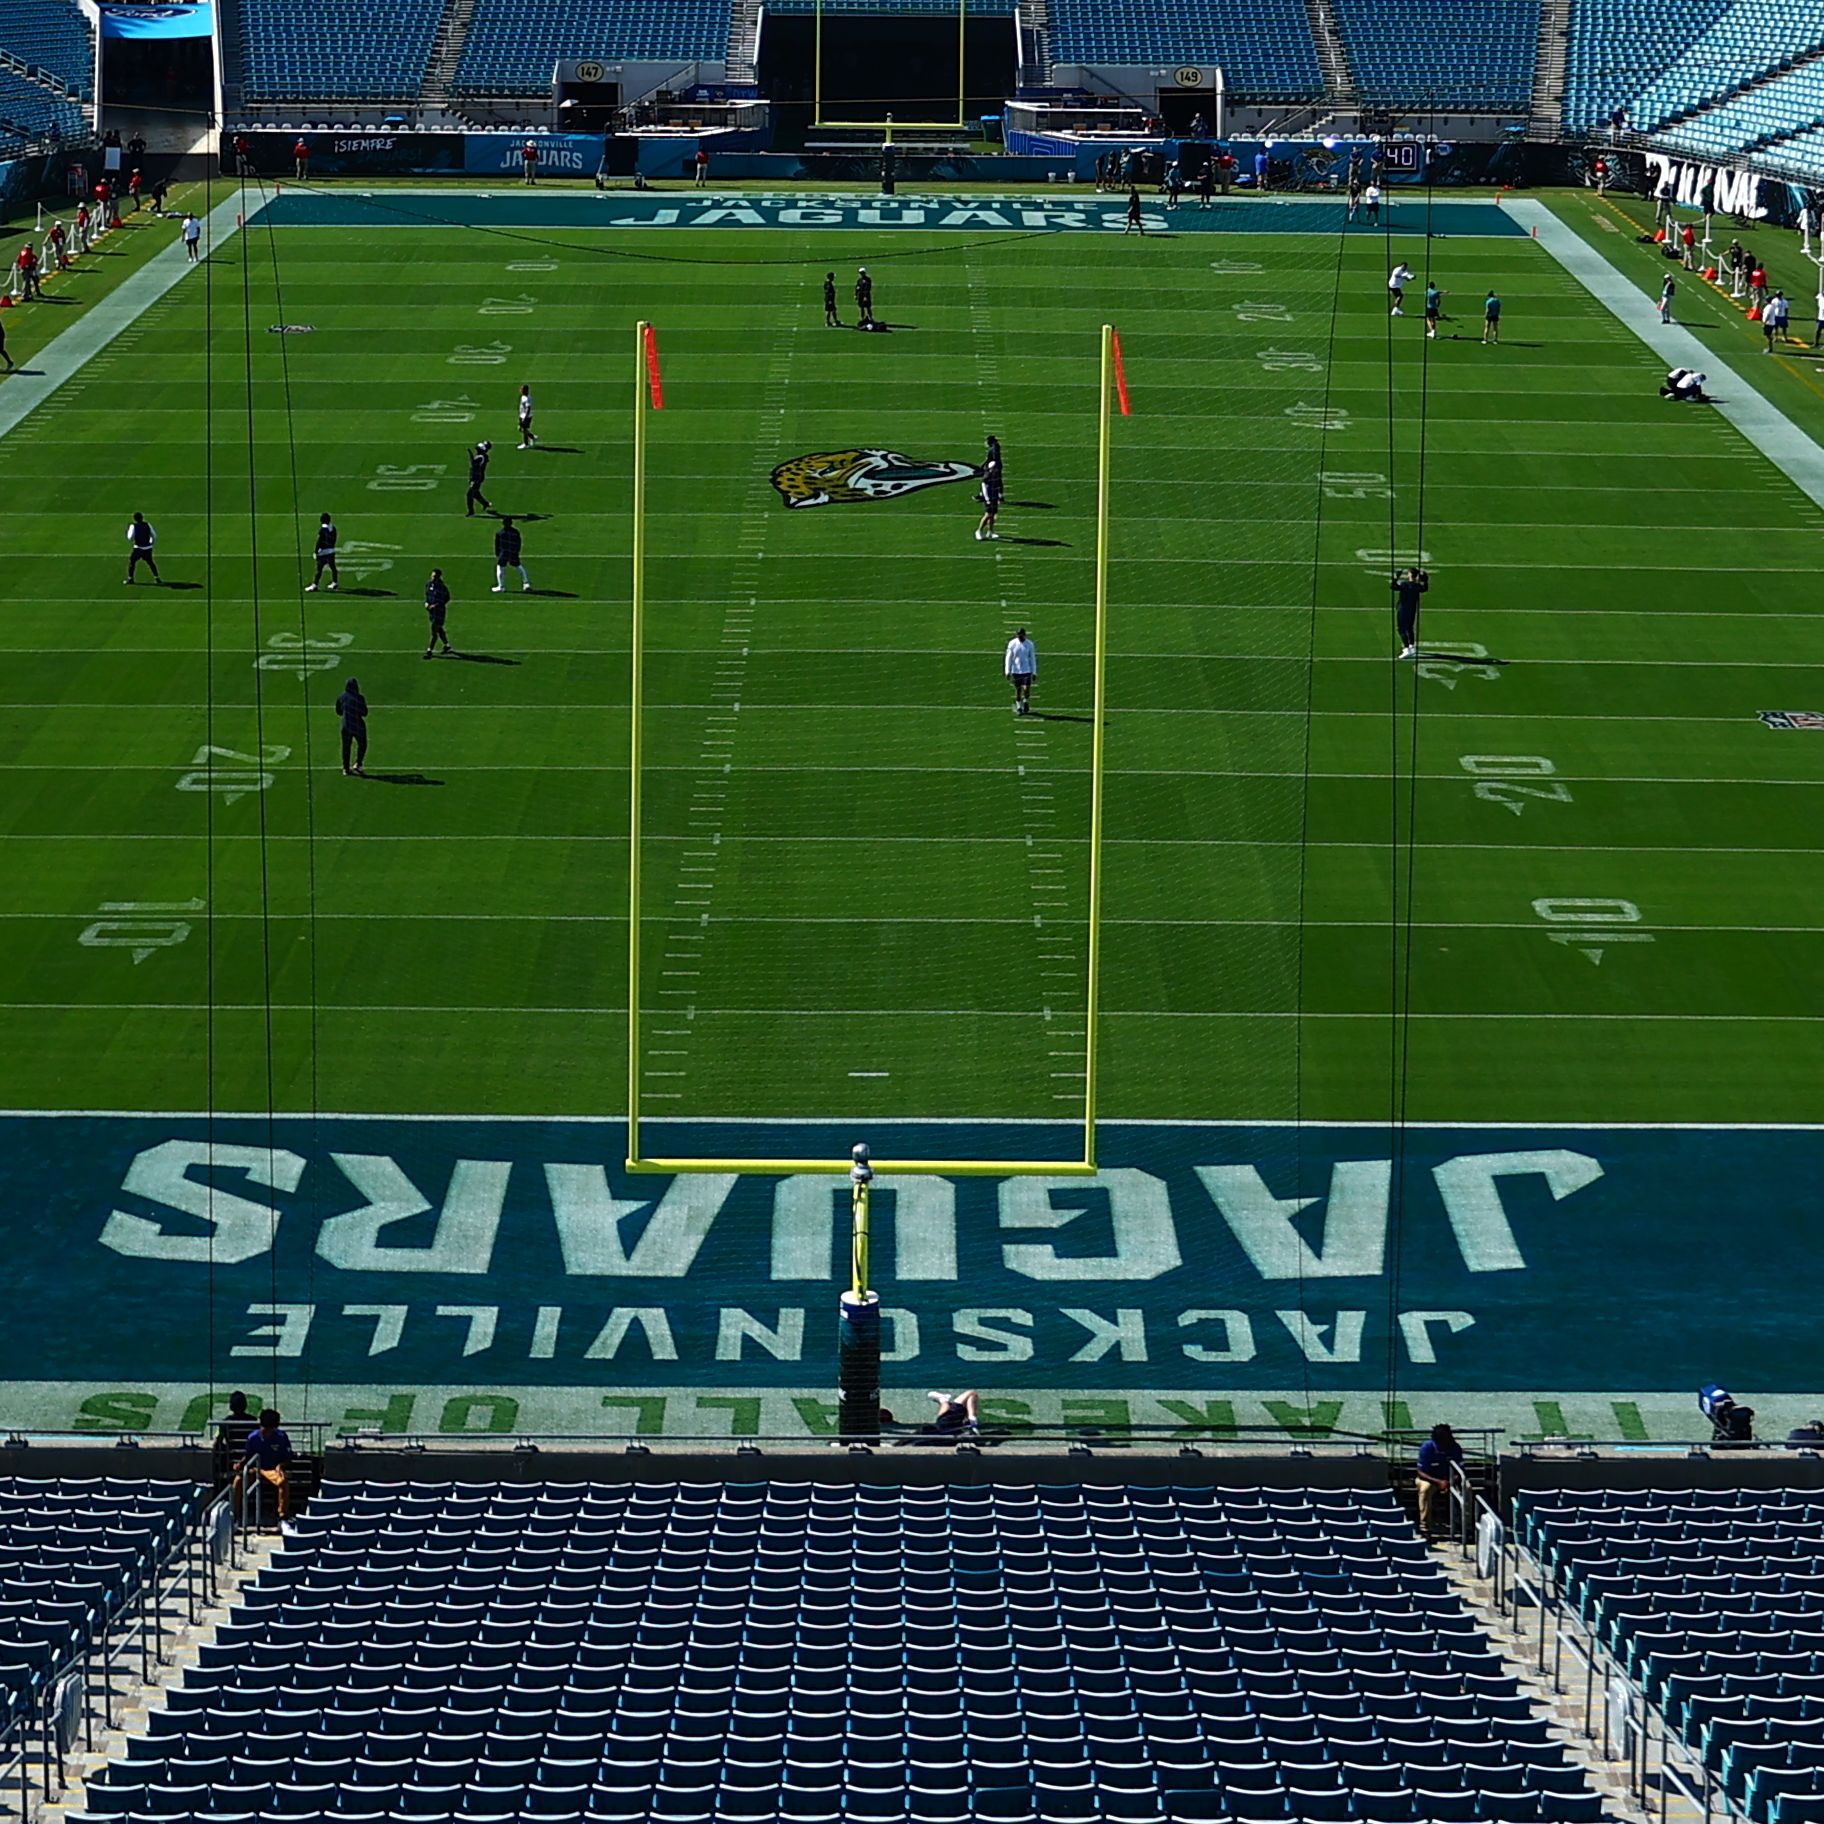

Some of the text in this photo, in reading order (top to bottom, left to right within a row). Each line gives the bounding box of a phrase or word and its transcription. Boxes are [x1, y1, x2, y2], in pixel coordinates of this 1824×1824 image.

[581, 66, 599, 77] 147
[1180, 71, 1198, 82] 149
[501, 148, 584, 170] JAUARS
[510, 139, 575, 150] JACONVILLE
[1387, 147, 1413, 165] 40
[609, 207, 1170, 230] JAGUARS
[685, 198, 1099, 211] JACKSONVILLE
[252, 632, 356, 671] 30
[175, 744, 292, 792] 20
[1458, 754, 1575, 804] 20
[77, 896, 207, 947] 10
[1530, 897, 1656, 945] 10
[97, 1138, 1606, 1282] JAGUARS
[228, 1302, 1477, 1364] JACKSONVILLE
